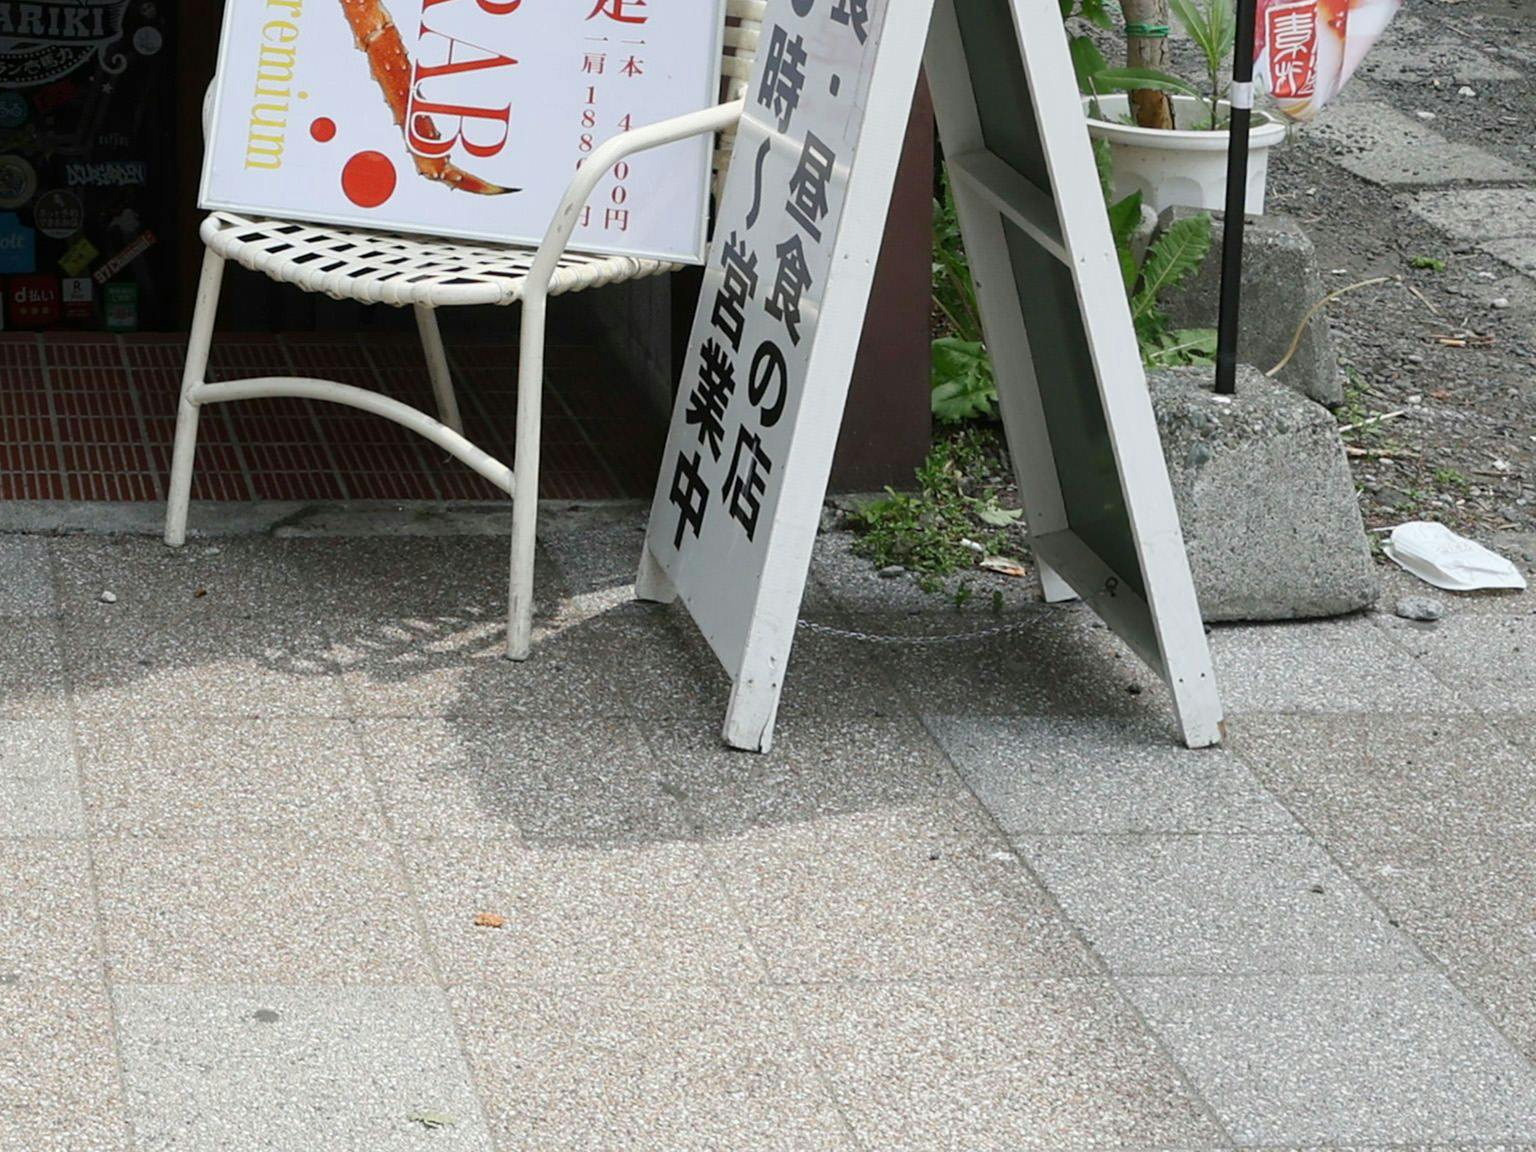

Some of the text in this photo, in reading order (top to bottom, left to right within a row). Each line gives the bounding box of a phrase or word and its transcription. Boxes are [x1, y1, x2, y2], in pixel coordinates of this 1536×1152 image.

[581, 35, 609, 75] 一肩
[604, 38, 647, 232] 一本 400円
